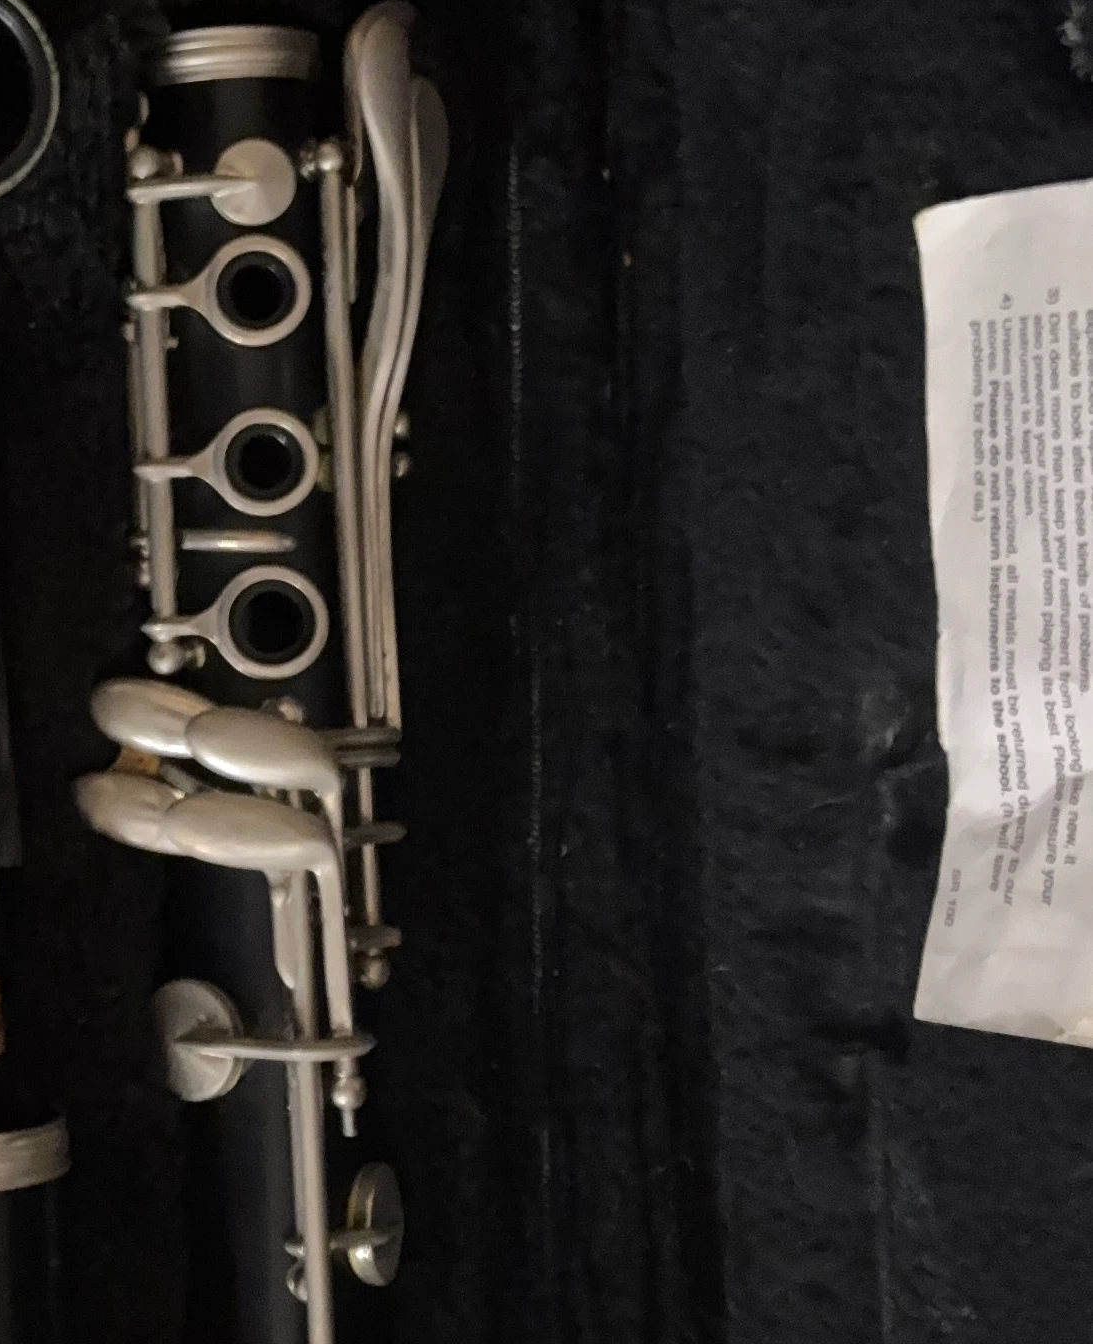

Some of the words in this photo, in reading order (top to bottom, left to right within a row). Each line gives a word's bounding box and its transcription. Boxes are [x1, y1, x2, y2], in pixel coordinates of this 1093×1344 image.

[1002, 317, 1012, 375] Unless
[1034, 314, 1043, 350] also
[1049, 313, 1060, 343] Dirt
[1068, 310, 1079, 377] suitable
[969, 320, 983, 396] problems
[1019, 316, 1031, 404] instrument
[1050, 350, 1061, 390] does
[1033, 355, 1046, 427] prevents
[1071, 382, 1081, 399] to
[974, 402, 984, 422] for
[989, 380, 999, 439] Please
[1004, 381, 1014, 461] otherwise
[1021, 410, 1031, 424] is
[1051, 397, 1061, 440] more
[1072, 404, 1083, 439] look
[974, 429, 985, 464] both
[990, 444, 999, 467] do
[1020, 429, 1032, 464] kept
[1034, 433, 1045, 469] your
[1053, 446, 1063, 483] than
[1073, 446, 1084, 483] after
[974, 471, 985, 485] of
[990, 472, 1001, 501] not
[1039, 475, 1051, 562] instrument
[1054, 488, 1065, 530] keep
[1075, 489, 1086, 537] these
[990, 507, 1001, 560] return
[1055, 535, 1067, 571] your
[1077, 542, 1089, 587] kinds
[1007, 565, 1018, 583] all
[1043, 569, 1054, 606] from
[1005, 589, 1017, 645] rentals
[1079, 593, 1090, 609] of
[1059, 578, 1070, 666] instrument
[1039, 612, 1055, 672] playing
[990, 677, 1001, 695] to
[1006, 650, 1017, 689] must
[1042, 677, 1055, 695] its
[1008, 696, 1020, 716] be
[1059, 672, 1072, 708] from
[992, 700, 1004, 728] the
[1012, 722, 1029, 790] returned
[1065, 715, 1083, 773] looking
[997, 734, 1012, 796] school.
[1053, 745, 1065, 801] Please
[1069, 776, 1084, 805] like
[997, 824, 1011, 848] will
[1011, 796, 1031, 852] directly
[1046, 807, 1060, 864] ensure
[989, 855, 1004, 892] save
[1008, 859, 1019, 873] to
[1064, 854, 1077, 865] it
[1003, 879, 1015, 905] our
[1041, 870, 1055, 905] your
